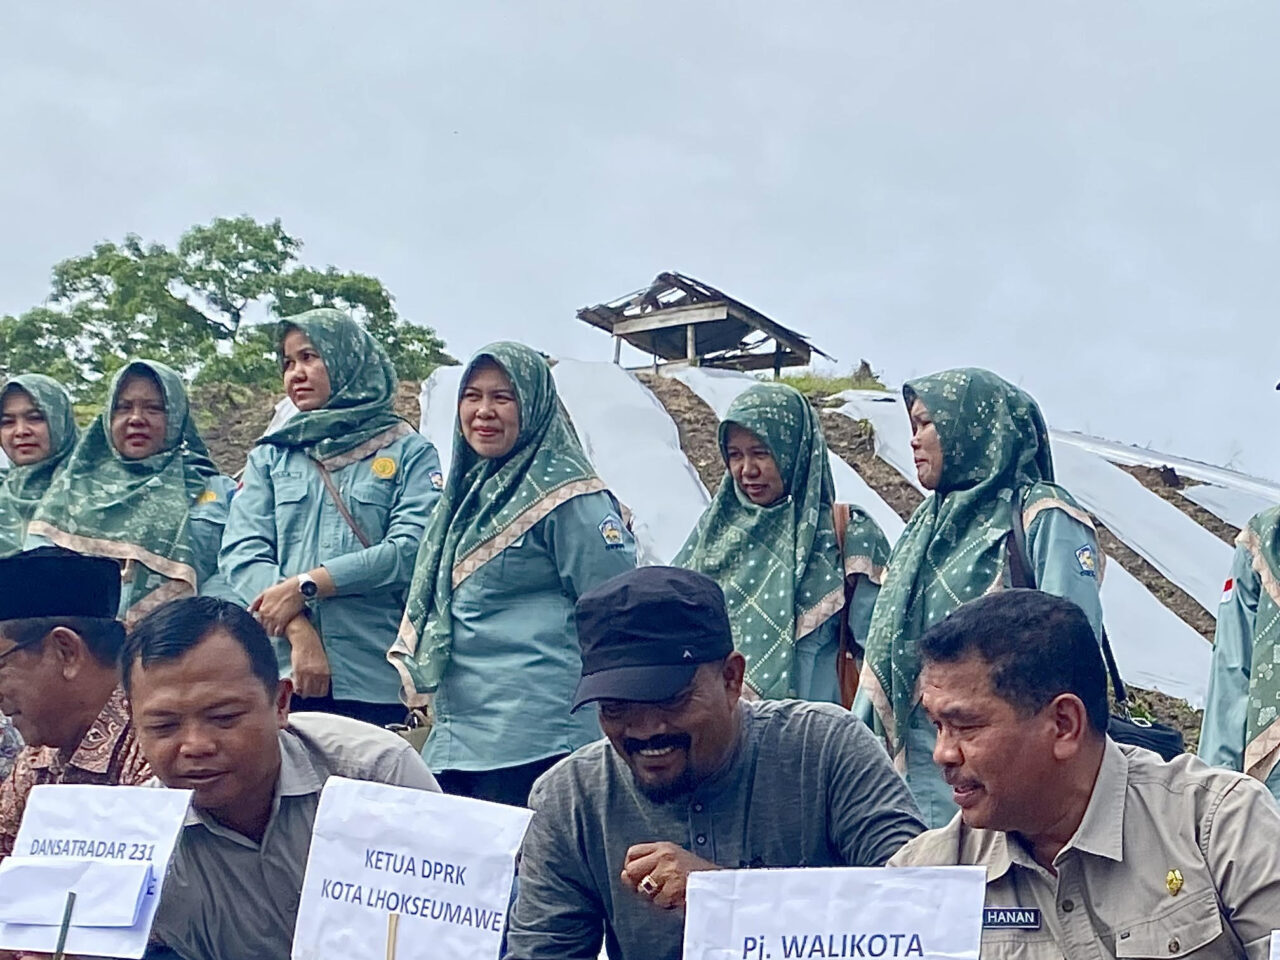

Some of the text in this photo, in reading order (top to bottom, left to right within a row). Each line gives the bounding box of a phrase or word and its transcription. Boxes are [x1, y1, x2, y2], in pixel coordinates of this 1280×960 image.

[29, 838, 156, 862] DANSATRADAR 231
[364, 848, 468, 887] KETUA DPRK
[320, 878, 504, 933] KOTA LHOKSEUMAWE
[987, 911, 1035, 924] HANAN
[781, 933, 925, 959] WALIKOTA
